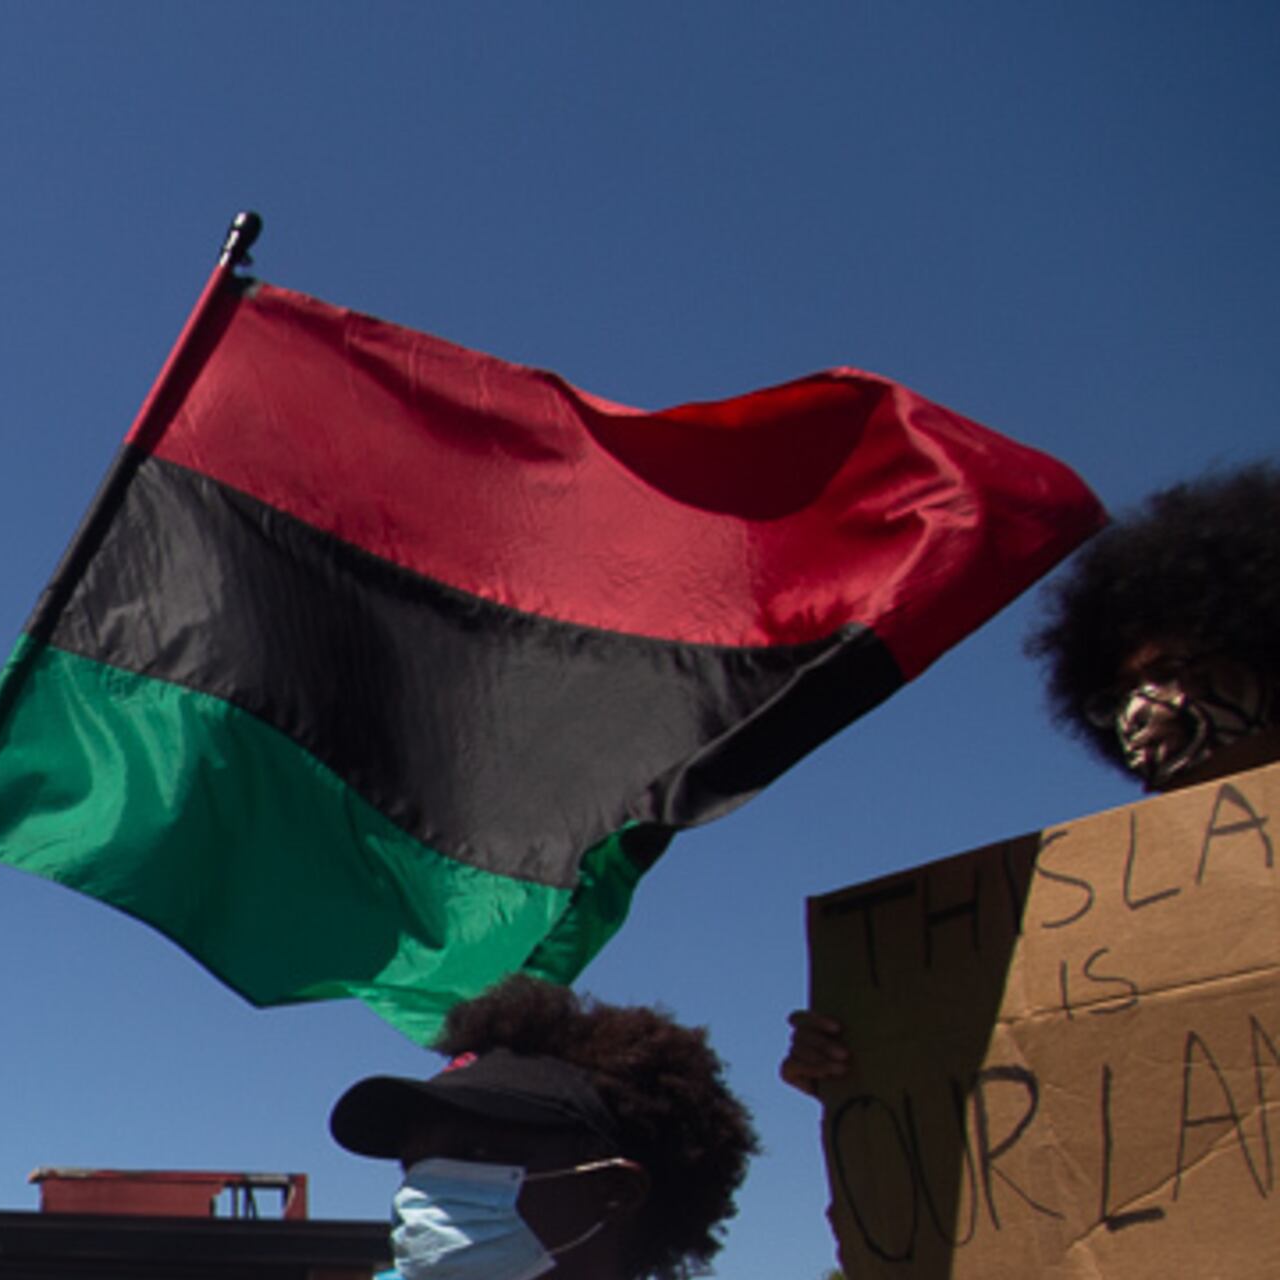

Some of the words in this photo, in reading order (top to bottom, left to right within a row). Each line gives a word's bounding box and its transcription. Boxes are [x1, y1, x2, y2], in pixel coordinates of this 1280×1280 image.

[1124, 782, 1274, 911] LA
[1059, 948, 1139, 1020] IS
[830, 1064, 1066, 1264] OUR
